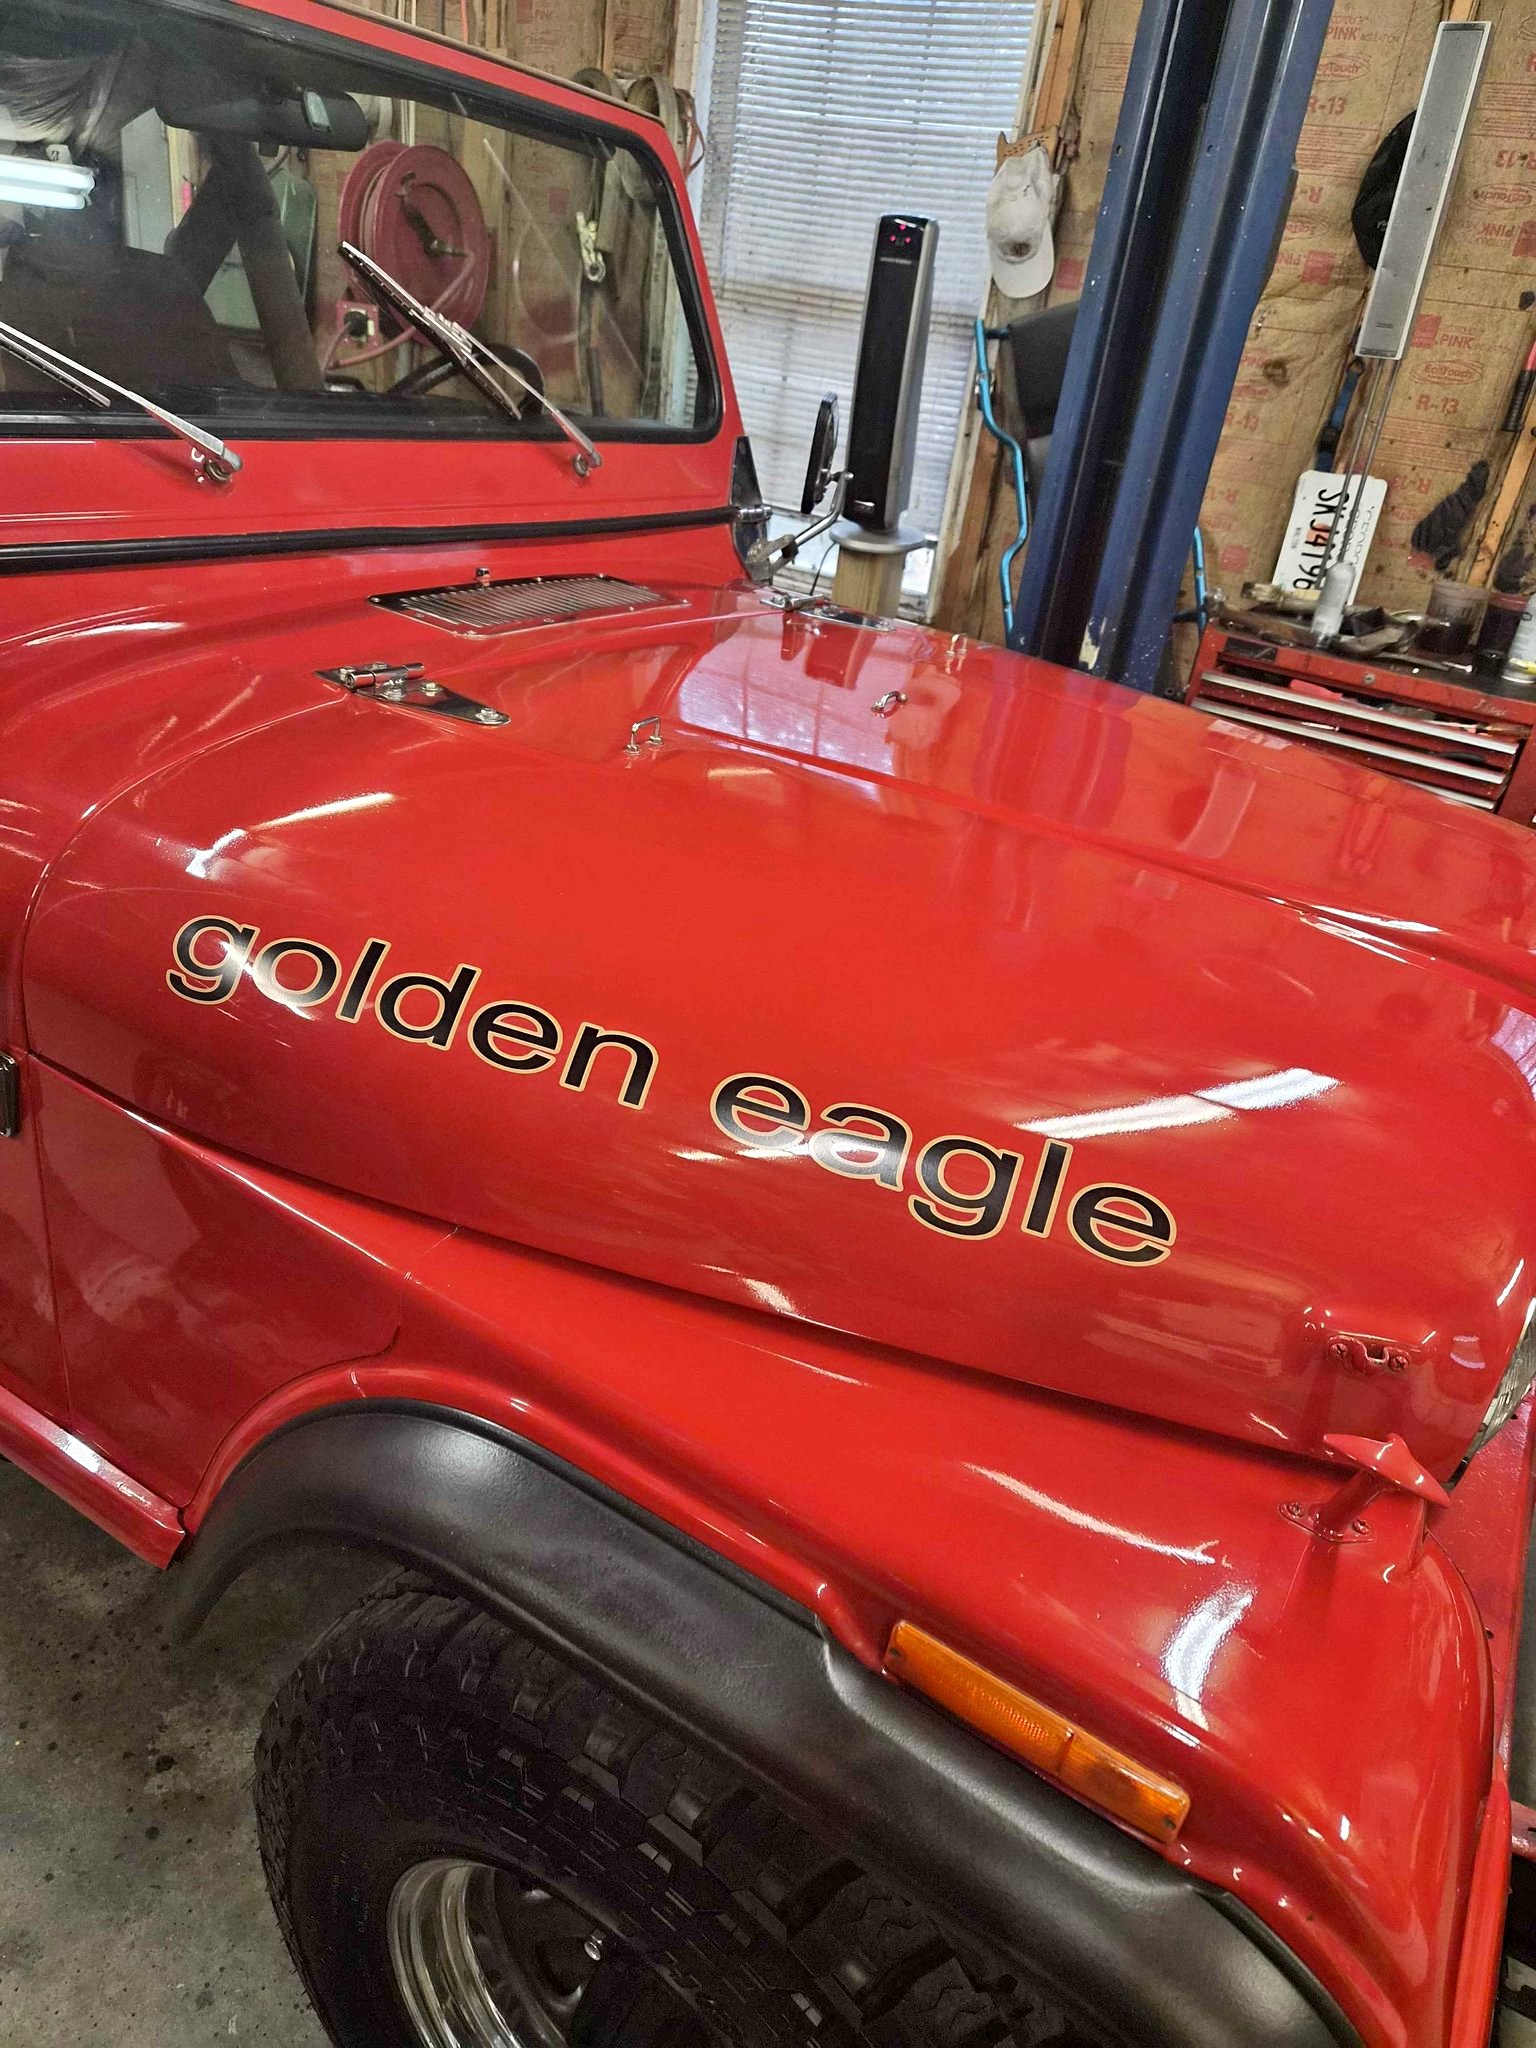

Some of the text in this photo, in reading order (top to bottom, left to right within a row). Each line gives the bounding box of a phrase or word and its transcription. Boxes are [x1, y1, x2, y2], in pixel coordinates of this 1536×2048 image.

[1439, 333, 1476, 350] PINK
[1415, 394, 1460, 416] R-13
[166, 914, 1177, 1267] golden eagle
